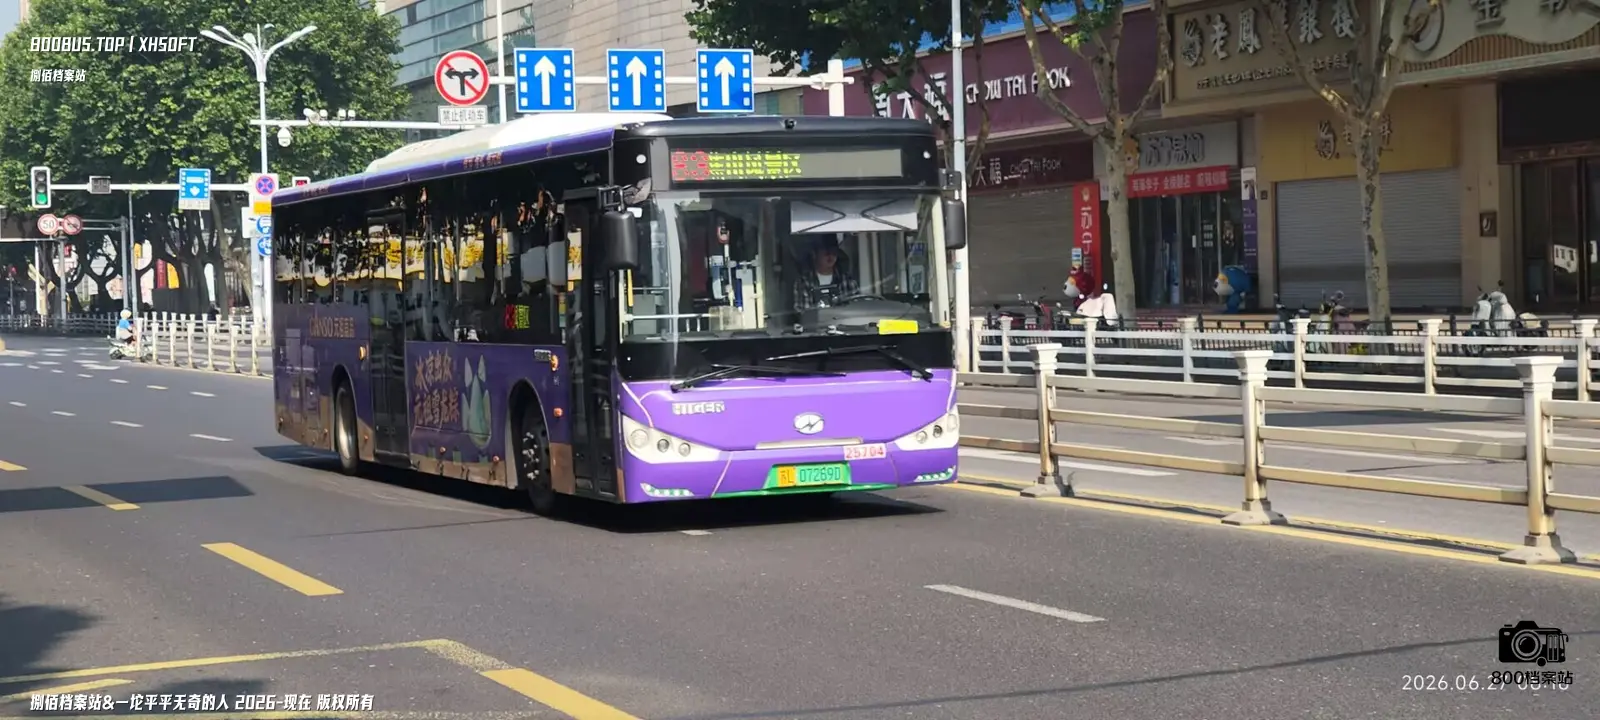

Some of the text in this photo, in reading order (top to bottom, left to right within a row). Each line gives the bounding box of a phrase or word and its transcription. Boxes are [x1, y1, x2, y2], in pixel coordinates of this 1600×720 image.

[1004, 74, 1027, 97] TAI
[1031, 66, 1071, 93] FOK
[443, 109, 484, 123] 禁止机动车
[967, 157, 1002, 187] 大福
[1042, 159, 1062, 172] FOOK
[42, 219, 55, 230] 50
[671, 401, 726, 415] HIGER
[845, 446, 884, 459] 25704
